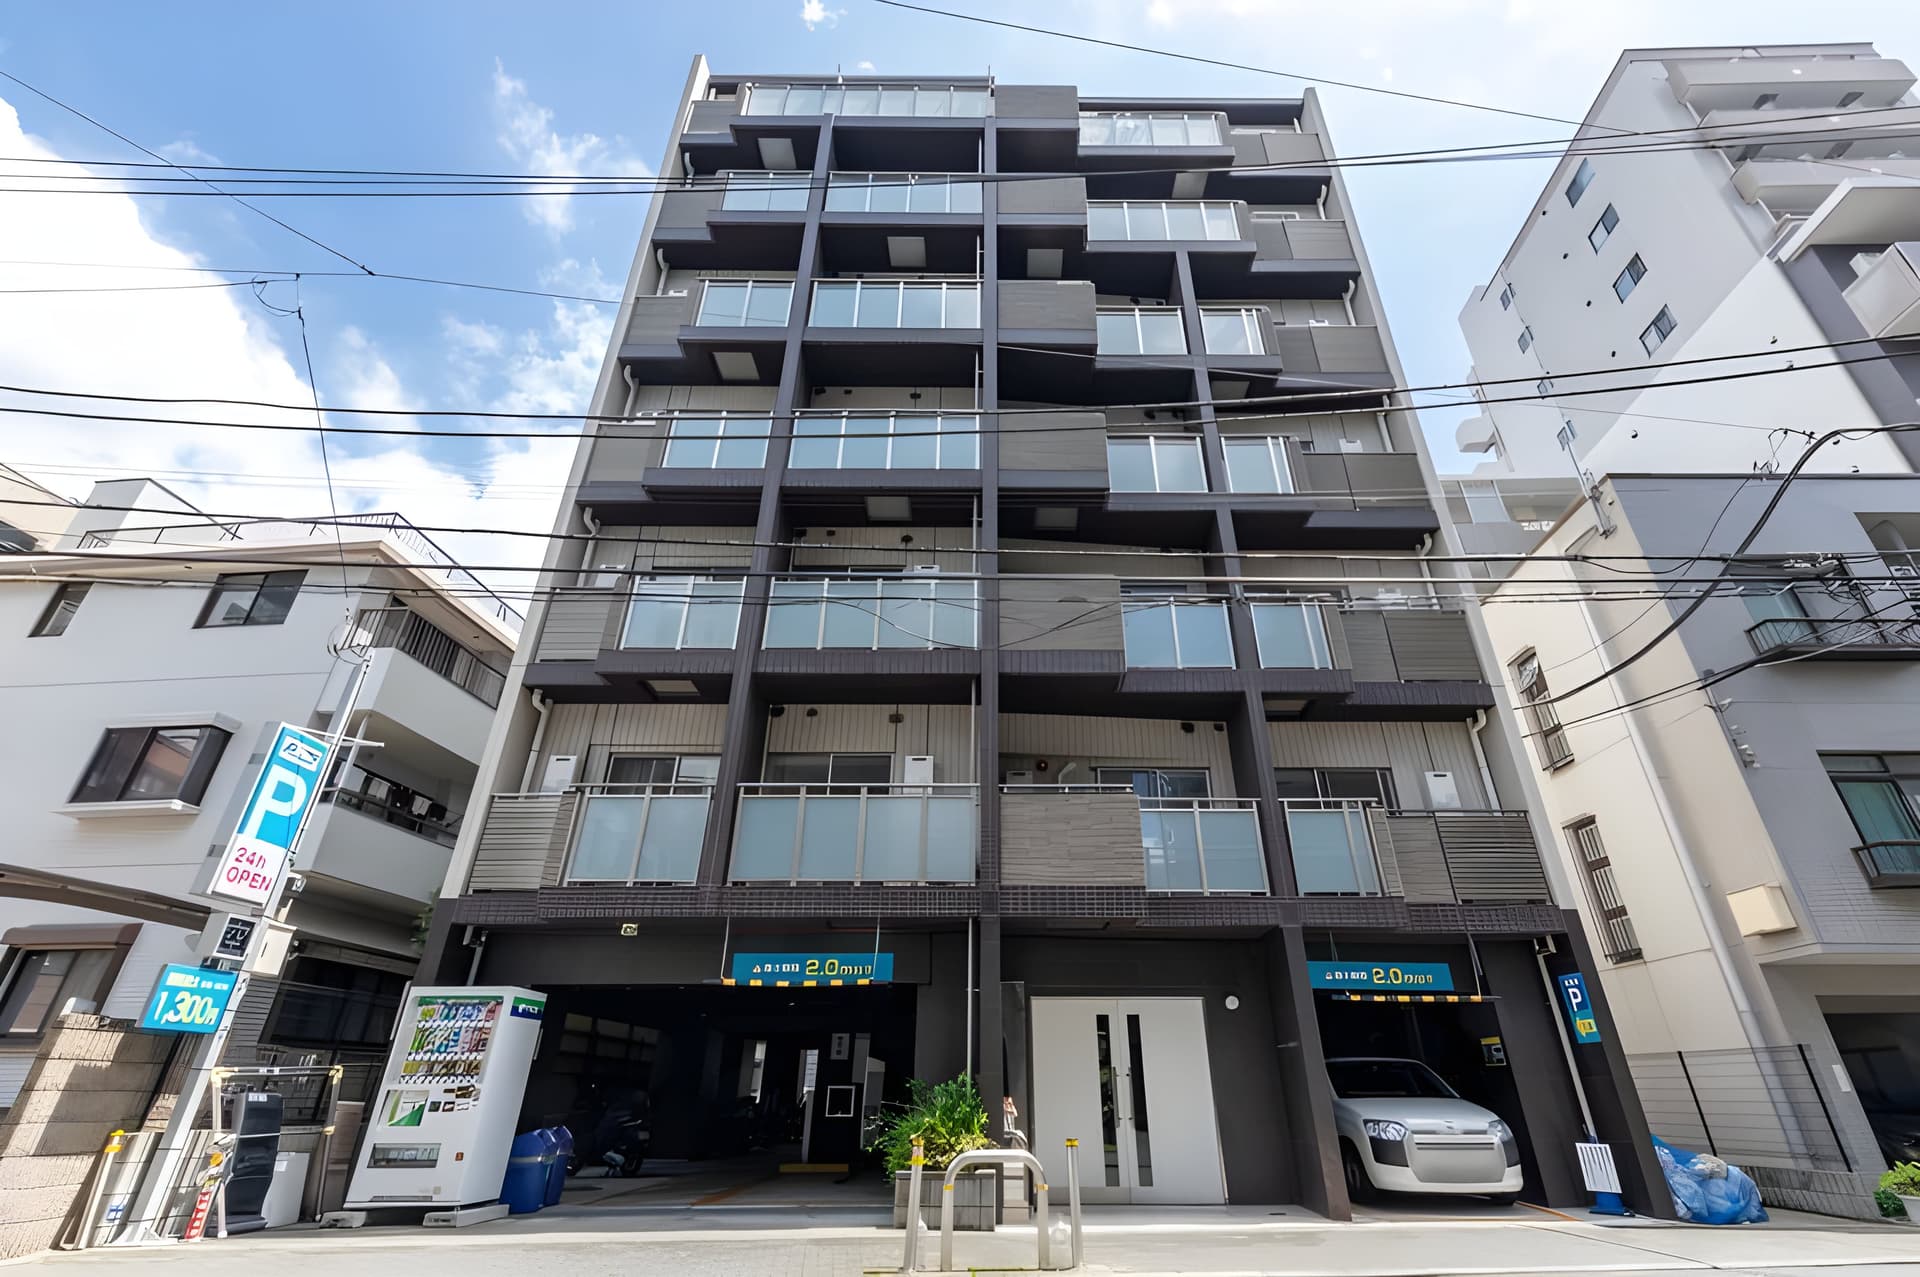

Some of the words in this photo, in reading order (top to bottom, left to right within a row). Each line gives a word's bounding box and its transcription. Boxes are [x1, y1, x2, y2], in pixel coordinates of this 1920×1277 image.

[242, 764, 307, 839] P
[226, 866, 272, 891] OPEN
[1567, 987, 1582, 1012] P
